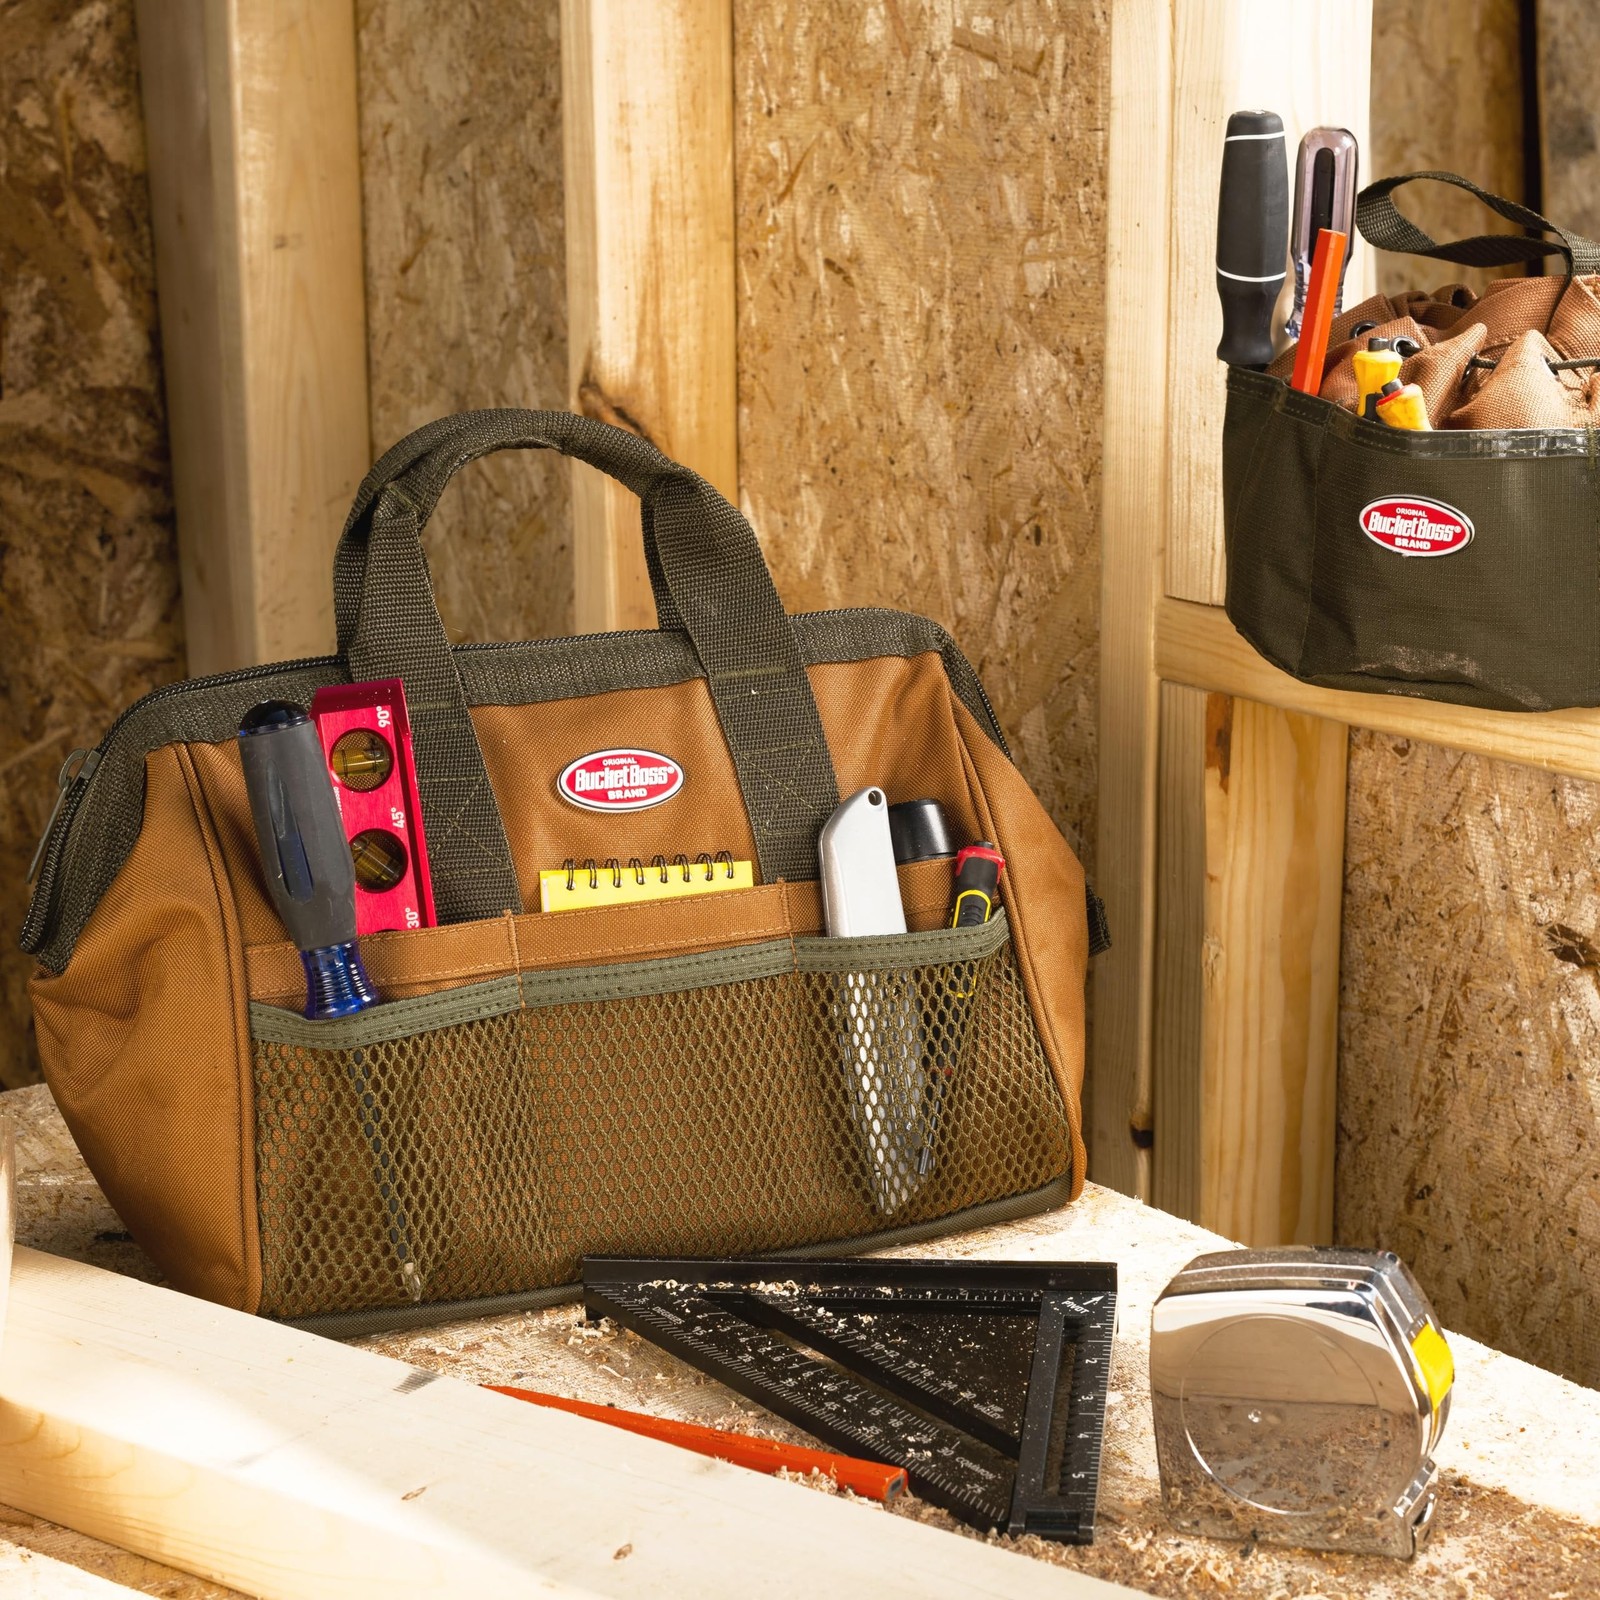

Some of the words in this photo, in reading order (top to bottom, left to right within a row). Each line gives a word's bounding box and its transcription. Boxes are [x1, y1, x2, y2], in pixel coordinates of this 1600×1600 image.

[1396, 507, 1427, 517] ORIGINAL
[1395, 537, 1431, 550] BRAND
[602, 757, 637, 766] ORIGINAL
[607, 788, 647, 800] BRAND
[1061, 1300, 1089, 1314] PIVOT
[652, 1306, 685, 1324] DEGREES
[905, 1360, 920, 1368] 15
[920, 1369, 935, 1377] 18
[974, 1403, 1004, 1419] VALLEY
[868, 1407, 884, 1415] 15
[888, 1419, 903, 1427] 18
[936, 1447, 954, 1456] 30
